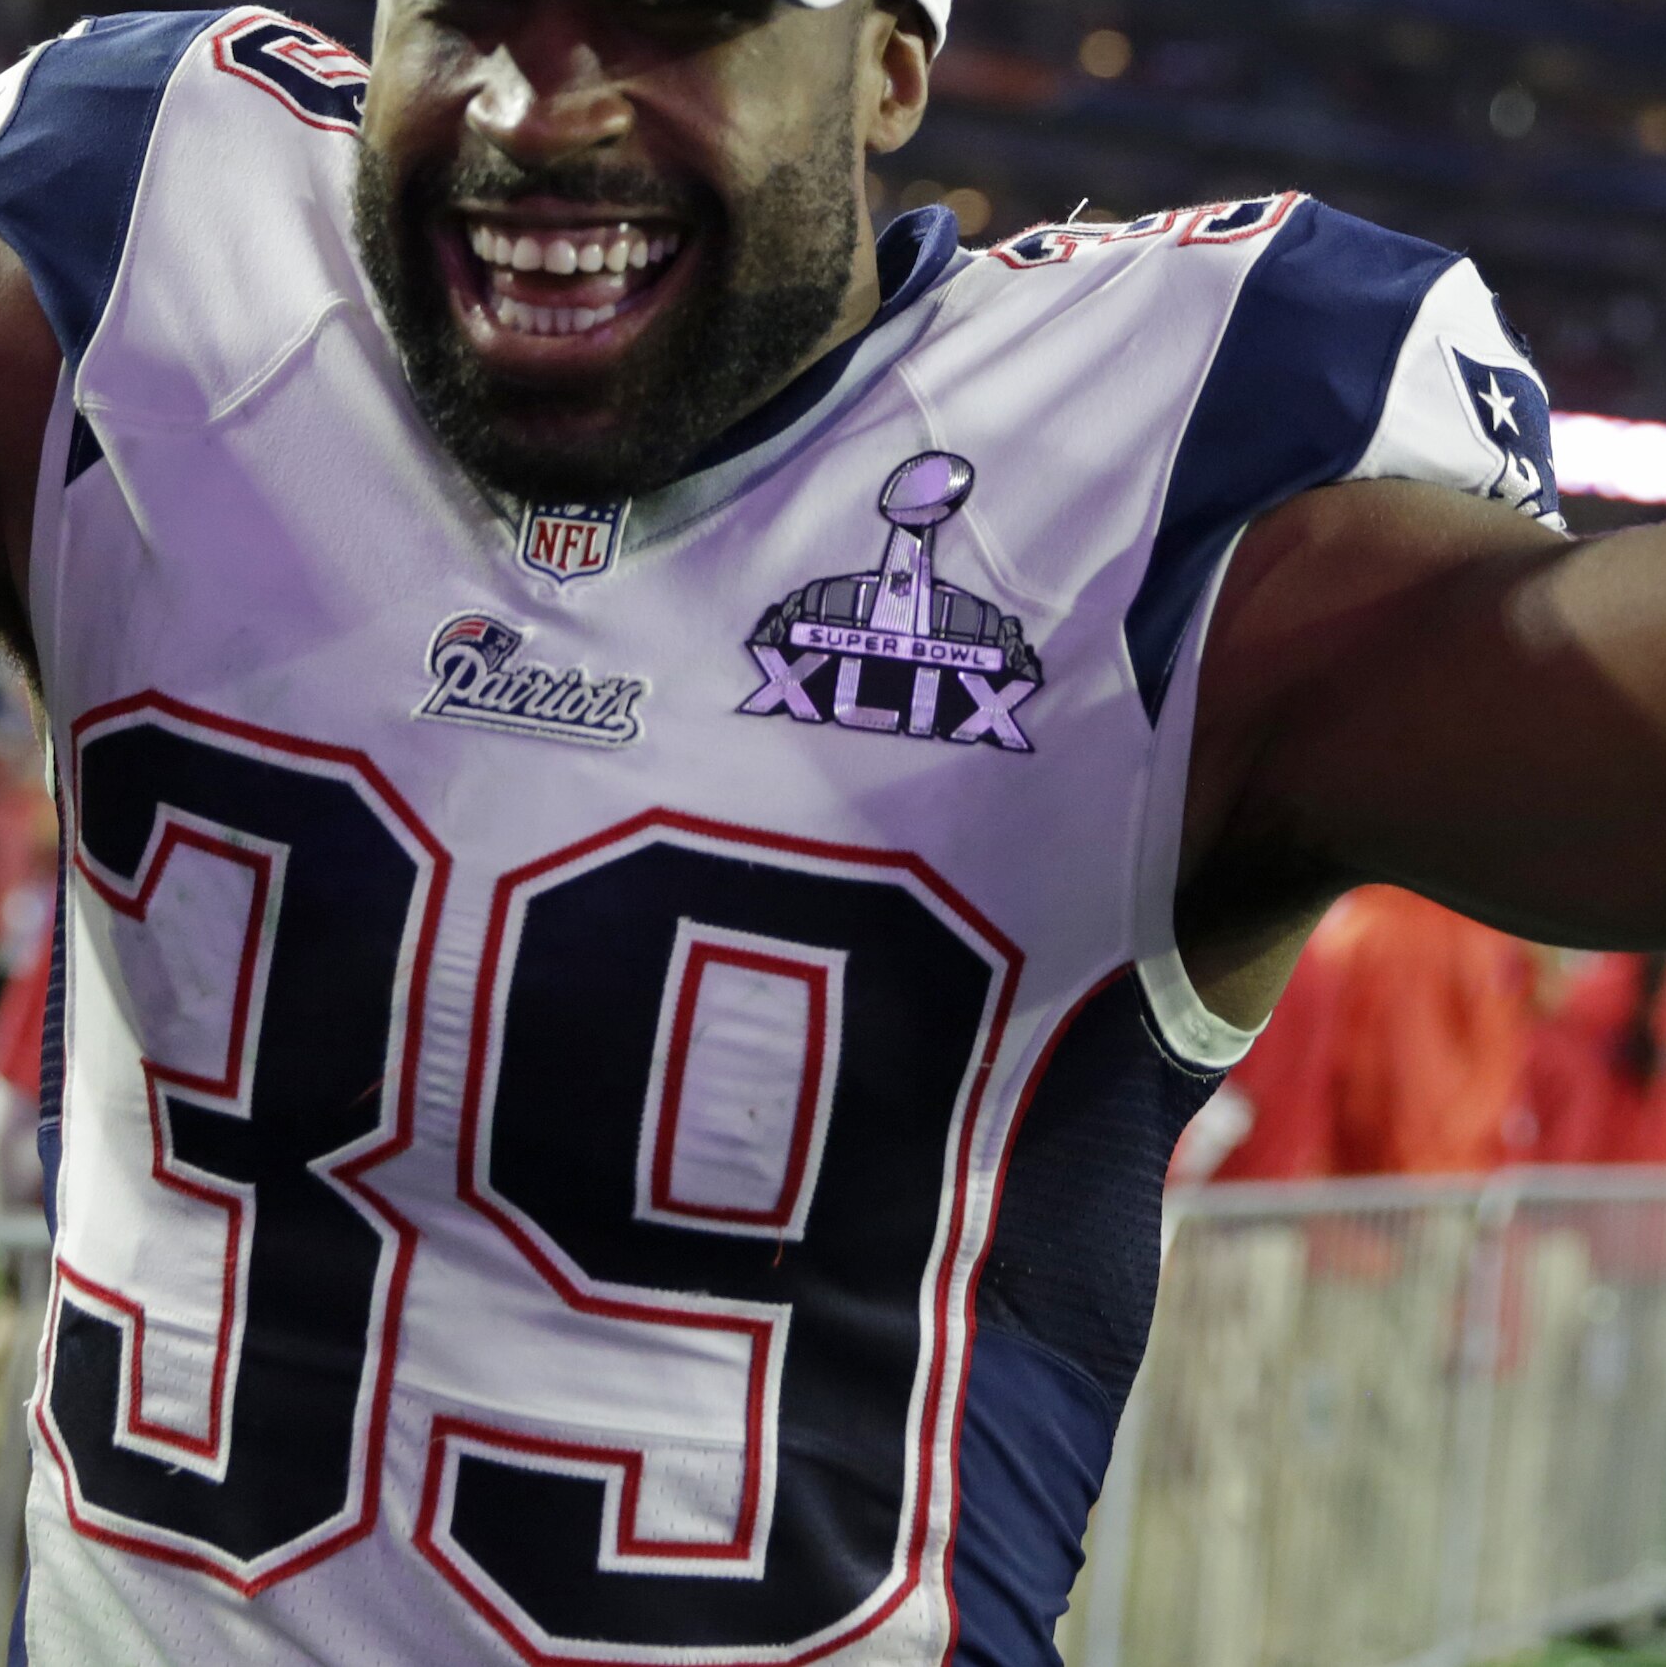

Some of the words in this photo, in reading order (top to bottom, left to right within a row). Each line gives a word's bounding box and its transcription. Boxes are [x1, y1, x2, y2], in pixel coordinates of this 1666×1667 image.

[531, 519, 602, 572] NFL
[425, 642, 644, 732] Patriots
[808, 627, 898, 654] SUPER
[911, 640, 986, 667] BOWL
[736, 643, 1036, 750] XLIX
[34, 689, 1024, 1667] 39
